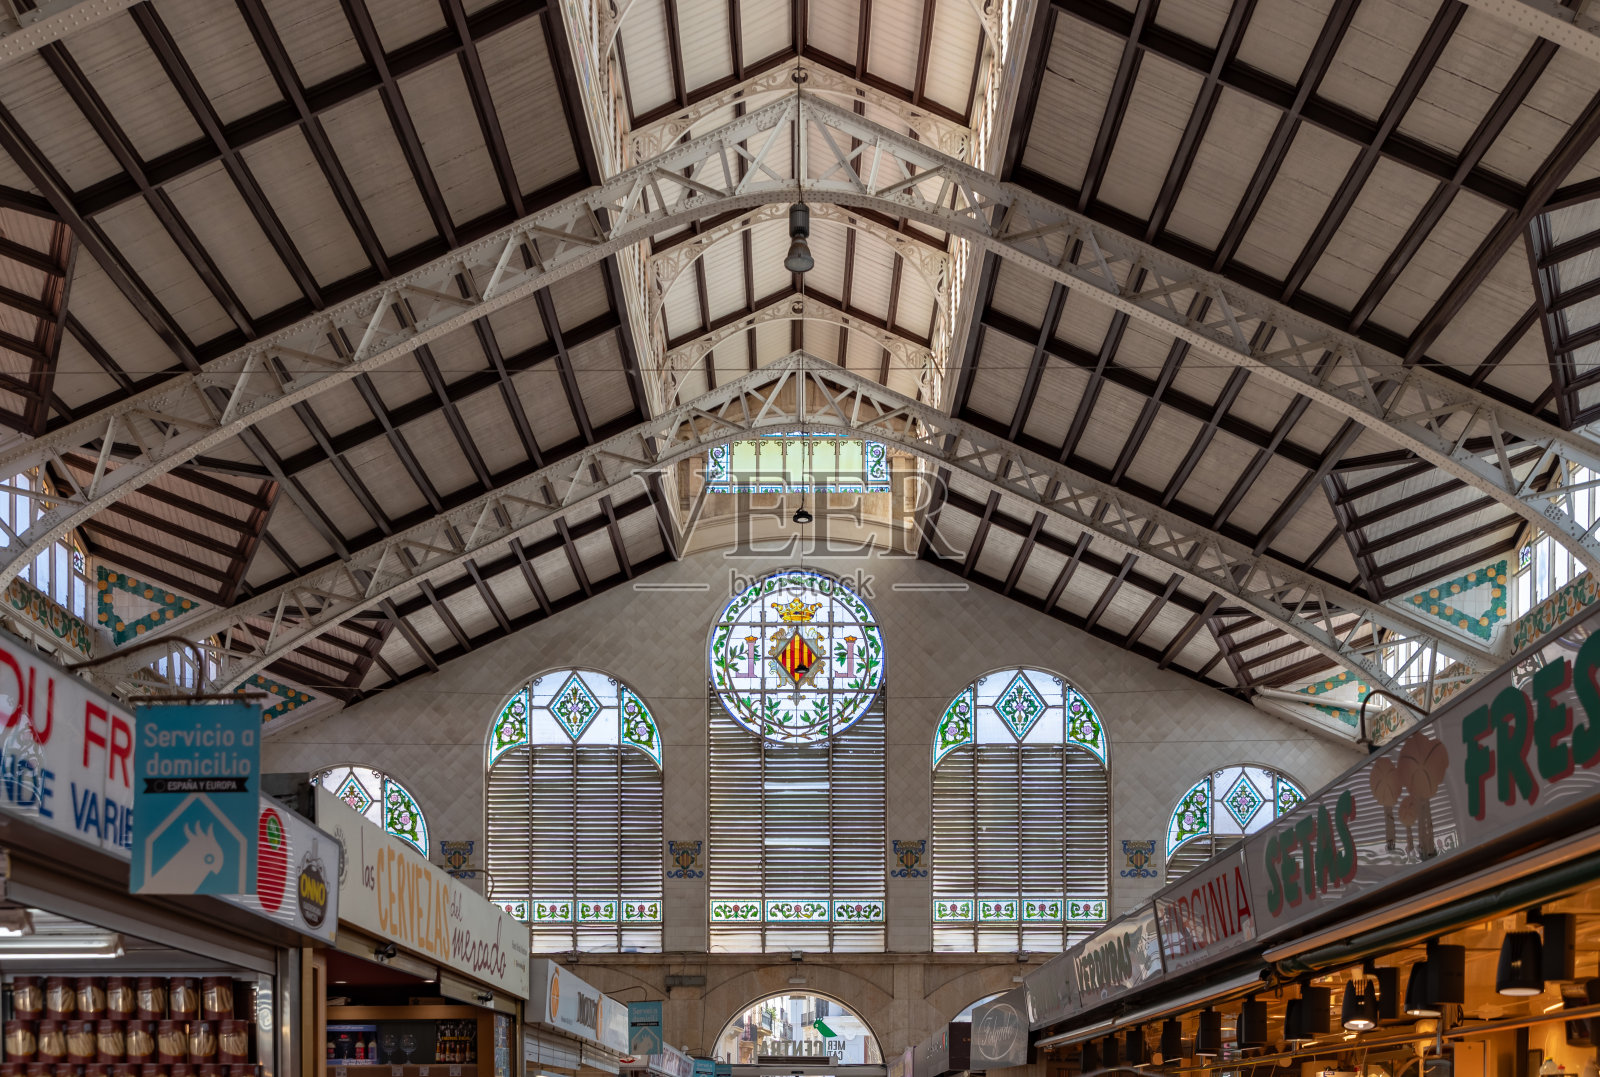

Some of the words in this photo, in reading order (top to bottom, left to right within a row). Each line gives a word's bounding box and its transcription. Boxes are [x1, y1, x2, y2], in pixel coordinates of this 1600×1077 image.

[83, 700, 135, 788] FR
[144, 723, 235, 747] Servicio
[242, 729, 254, 746] a
[146, 752, 251, 776] domicilio
[167, 779, 198, 791] ESPAÑA
[206, 781, 237, 790] EUROPA
[361, 825, 375, 891] las
[377, 843, 450, 961] CERVEZAS
[1265, 789, 1358, 918] SETAS
[1160, 866, 1253, 960] VIRGINIA
